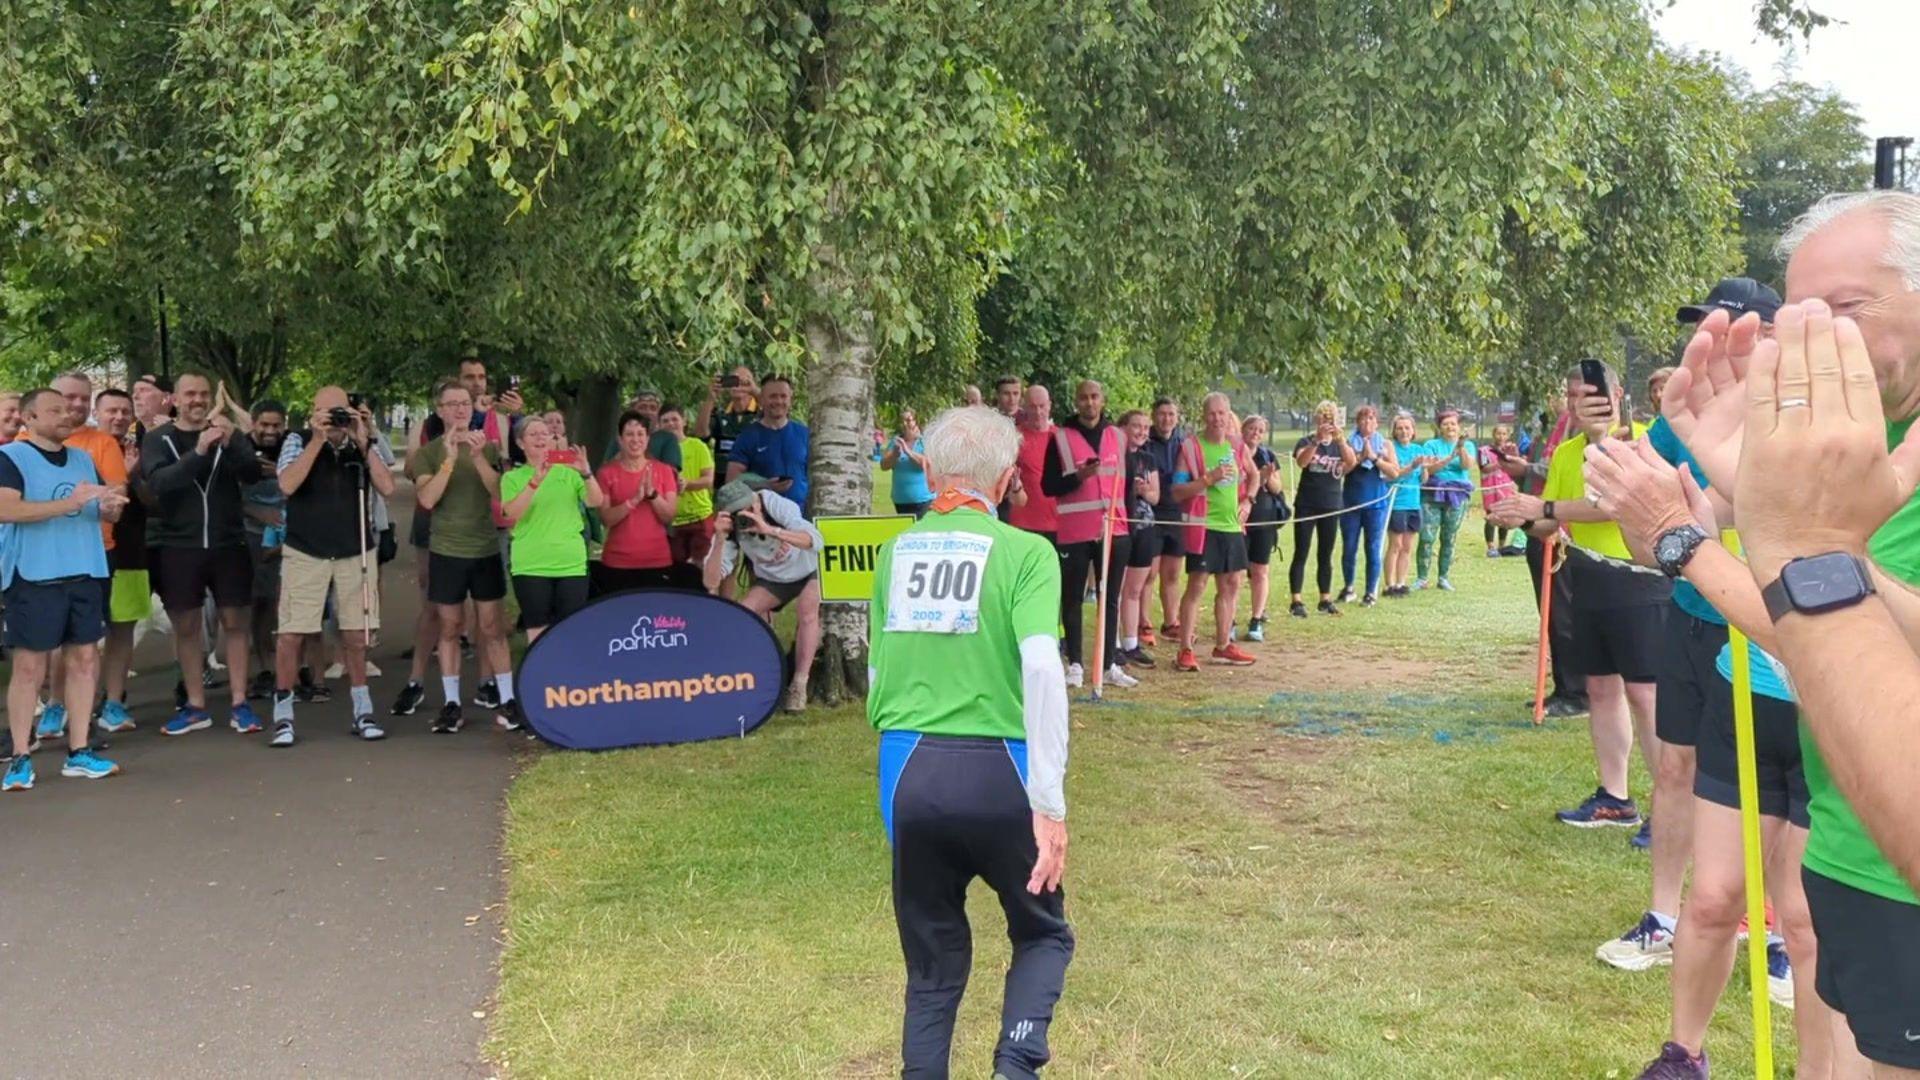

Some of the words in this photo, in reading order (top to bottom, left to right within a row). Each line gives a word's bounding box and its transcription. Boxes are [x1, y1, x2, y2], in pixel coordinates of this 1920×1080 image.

[824, 544, 882, 572] FINI
[931, 541, 941, 550] TO
[943, 540, 987, 553] BRIGHTON
[907, 559, 977, 602] 500
[912, 611, 942, 620] 2002
[608, 618, 688, 656] parkrun
[545, 672, 755, 709] Northampton
